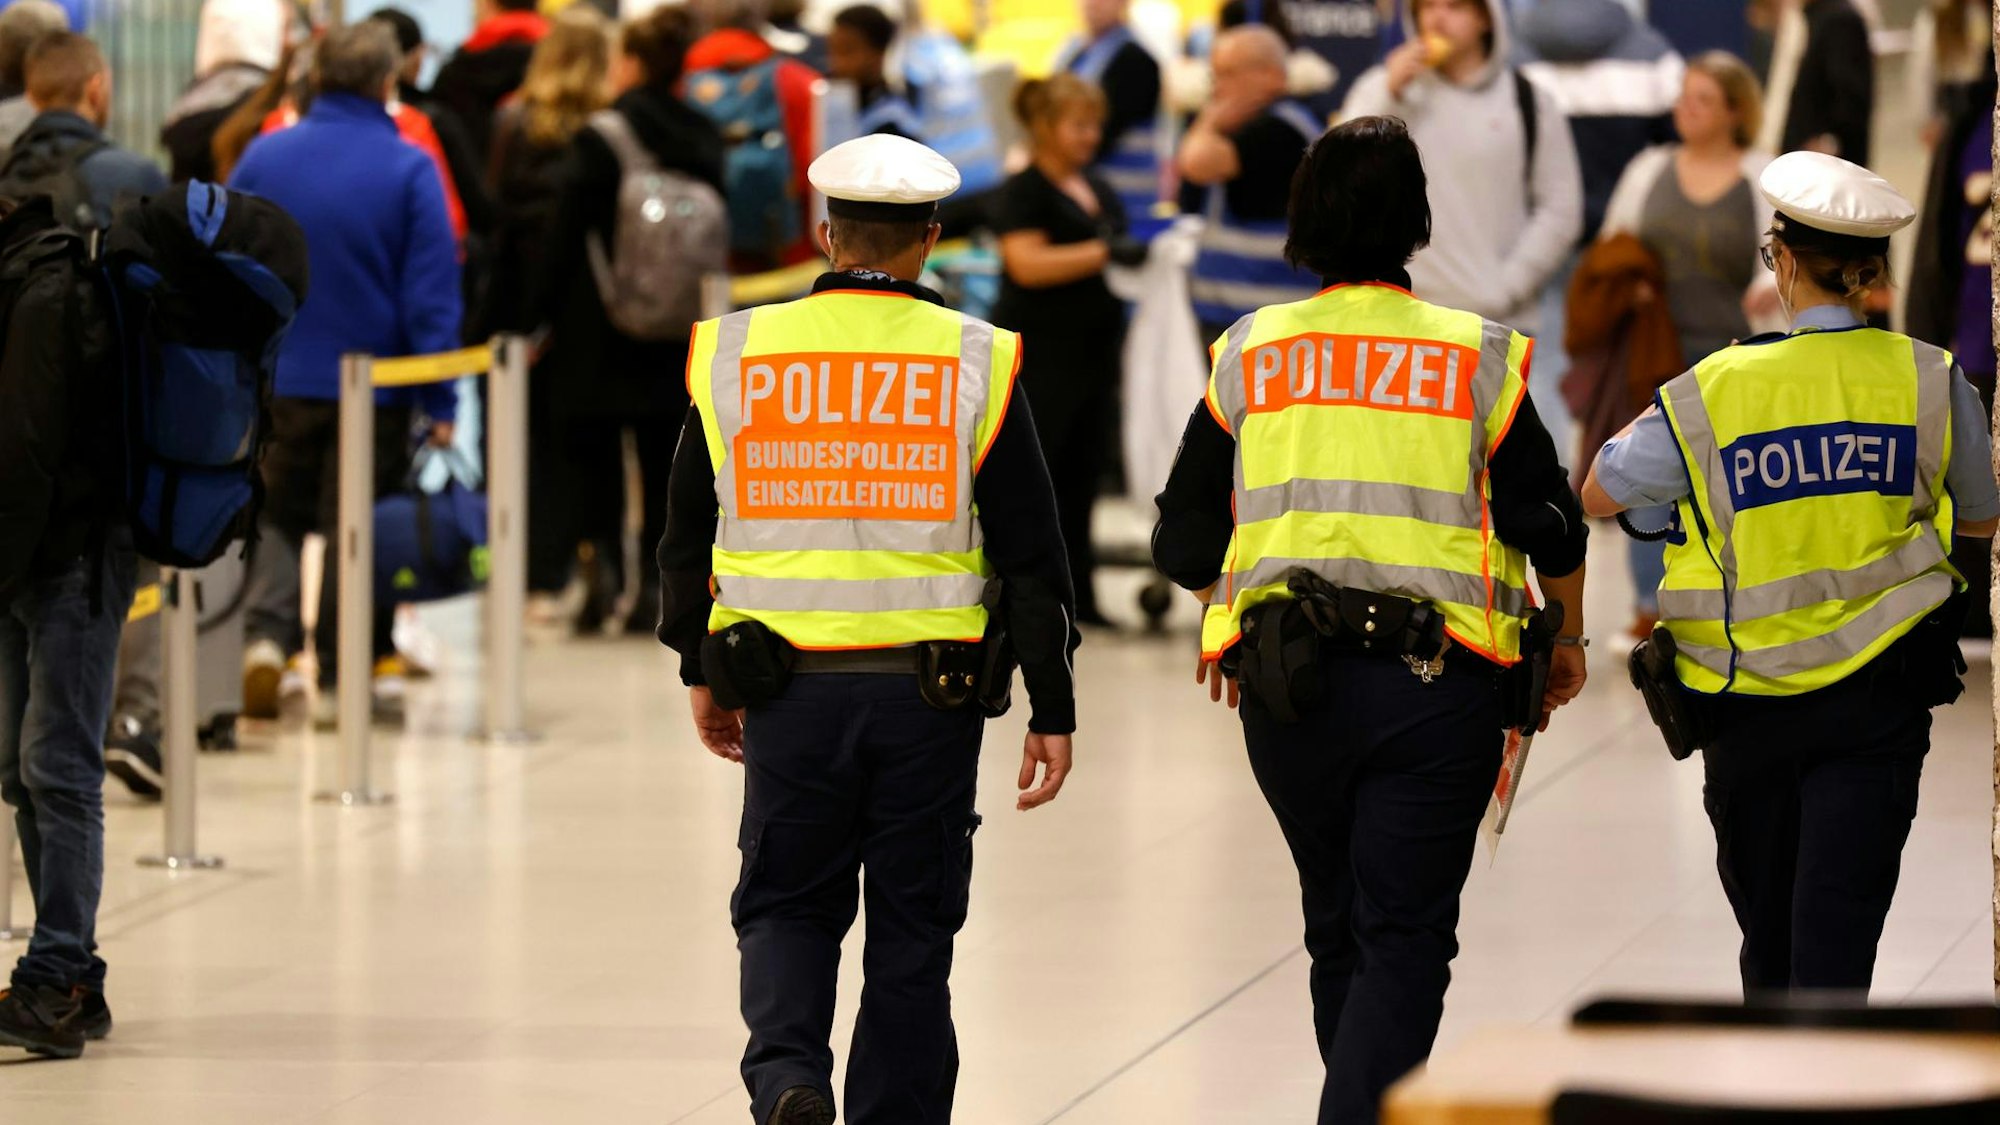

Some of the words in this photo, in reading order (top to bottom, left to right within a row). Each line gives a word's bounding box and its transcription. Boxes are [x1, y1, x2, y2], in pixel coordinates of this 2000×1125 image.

[743, 362, 953, 426] POLIZEI
[1254, 339, 1459, 410] POLIZEI
[747, 442, 946, 471] BUNDESPOLIZEI
[1735, 434, 1896, 494] POLIZEI
[748, 481, 945, 509] EINSATZLEITUNG
